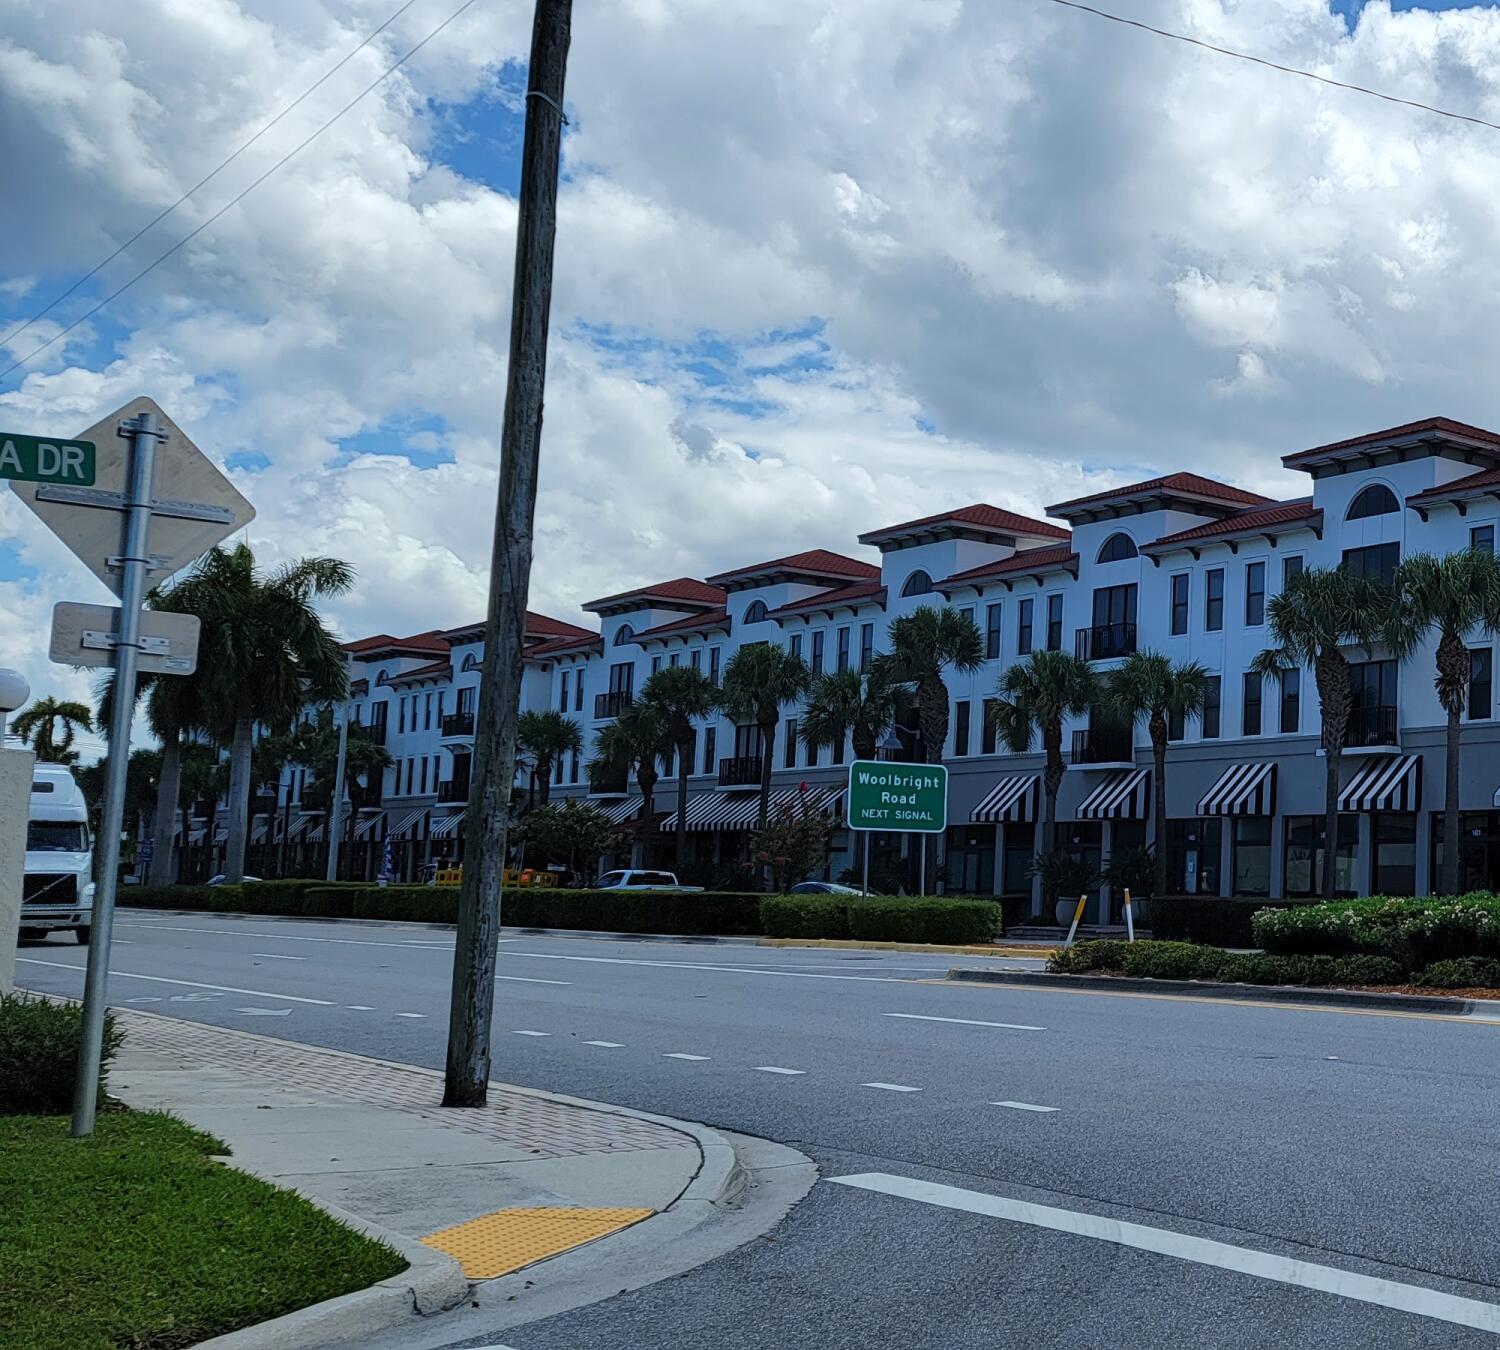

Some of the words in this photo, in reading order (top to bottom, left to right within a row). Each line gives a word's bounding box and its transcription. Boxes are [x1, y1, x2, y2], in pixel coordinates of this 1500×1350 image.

[37, 443, 85, 479] DR
[858, 772, 940, 790] Woolbright
[881, 791, 916, 805] Road
[861, 808, 889, 819] NEXT
[895, 810, 934, 821] SIGNAL
